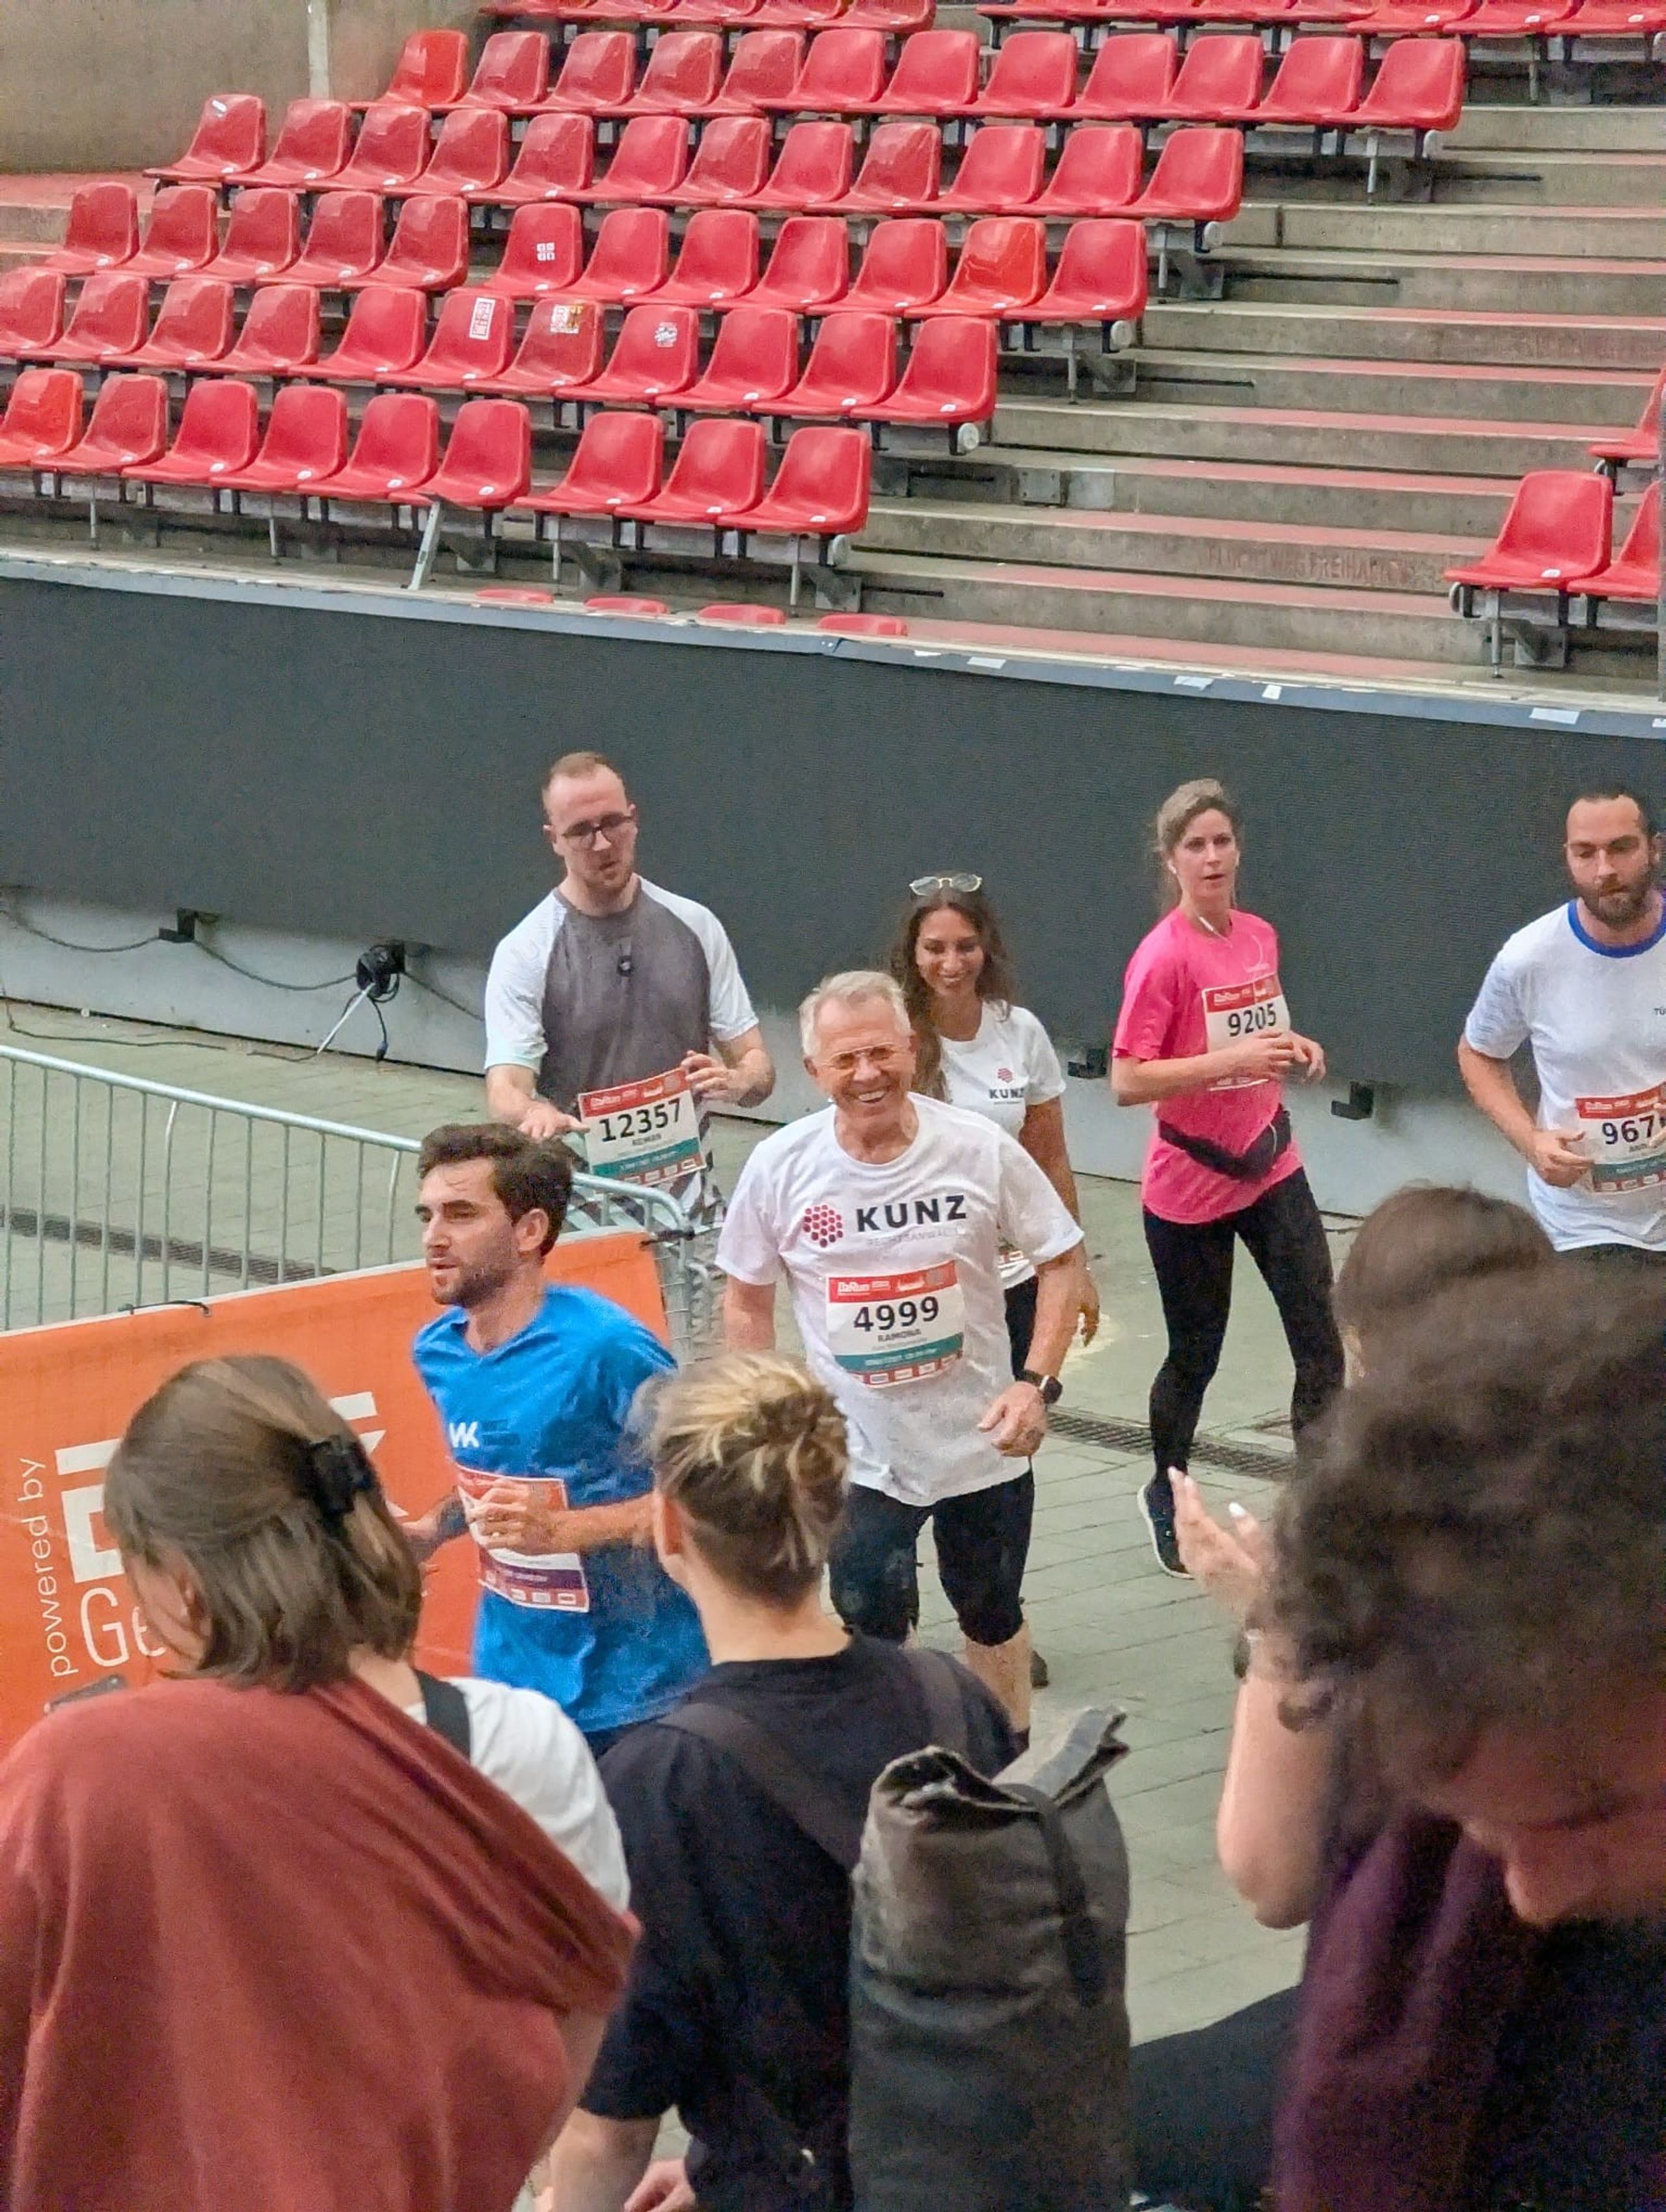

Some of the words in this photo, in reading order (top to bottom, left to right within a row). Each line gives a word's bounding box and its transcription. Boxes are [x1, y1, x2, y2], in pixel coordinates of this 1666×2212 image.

[1228, 1003, 1277, 1037] 9205
[989, 1087, 1024, 1099] KUNZ
[599, 1098, 680, 1142] 12357
[1602, 1114, 1666, 1145] 967
[856, 1194, 967, 1232] KUNZ
[853, 1296, 939, 1332] 4999
[17, 1457, 46, 1502] by
[20, 1515, 79, 1678] powered
